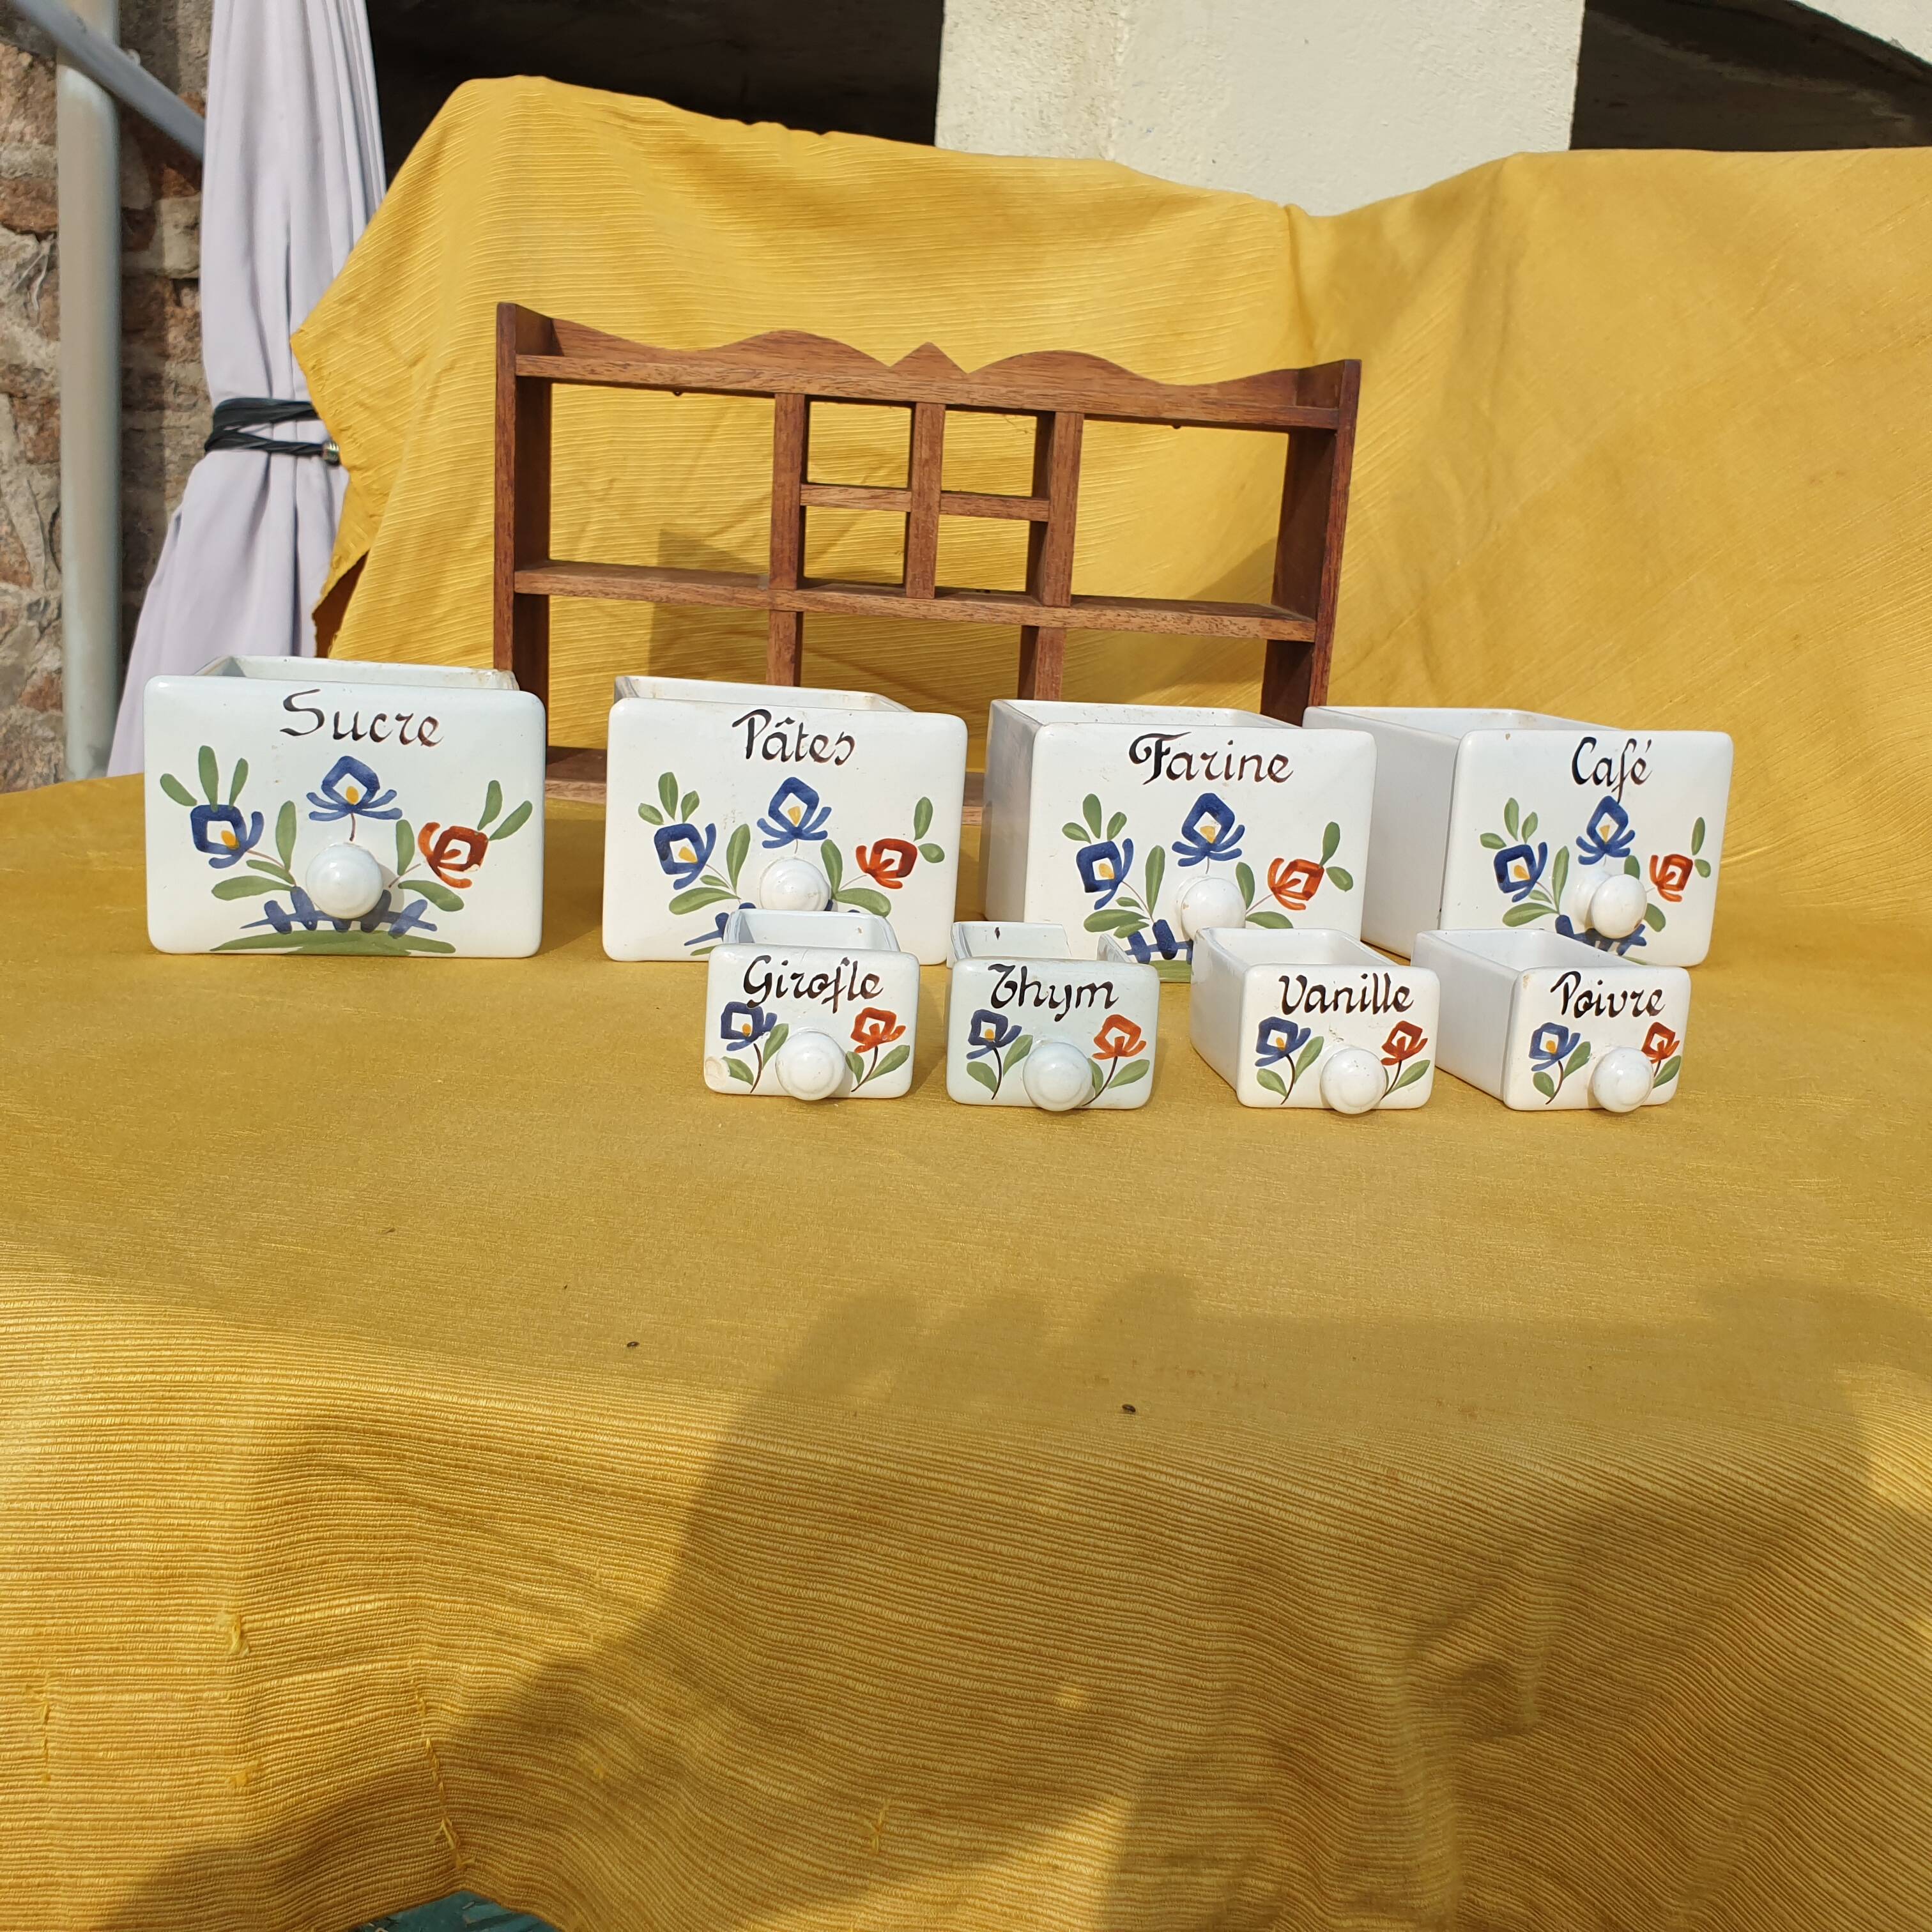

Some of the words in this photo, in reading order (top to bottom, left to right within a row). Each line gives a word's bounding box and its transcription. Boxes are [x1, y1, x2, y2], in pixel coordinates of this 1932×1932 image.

[279, 689, 445, 747] Sucre
[732, 709, 857, 765] Pâtes
[1129, 732, 1294, 785] Farine
[1572, 737, 1652, 804] Café
[742, 955, 884, 1013] Girofle
[988, 963, 1119, 1022] Thym
[1278, 972, 1414, 1015] Vanille
[1550, 970, 1666, 1018] Poivre
